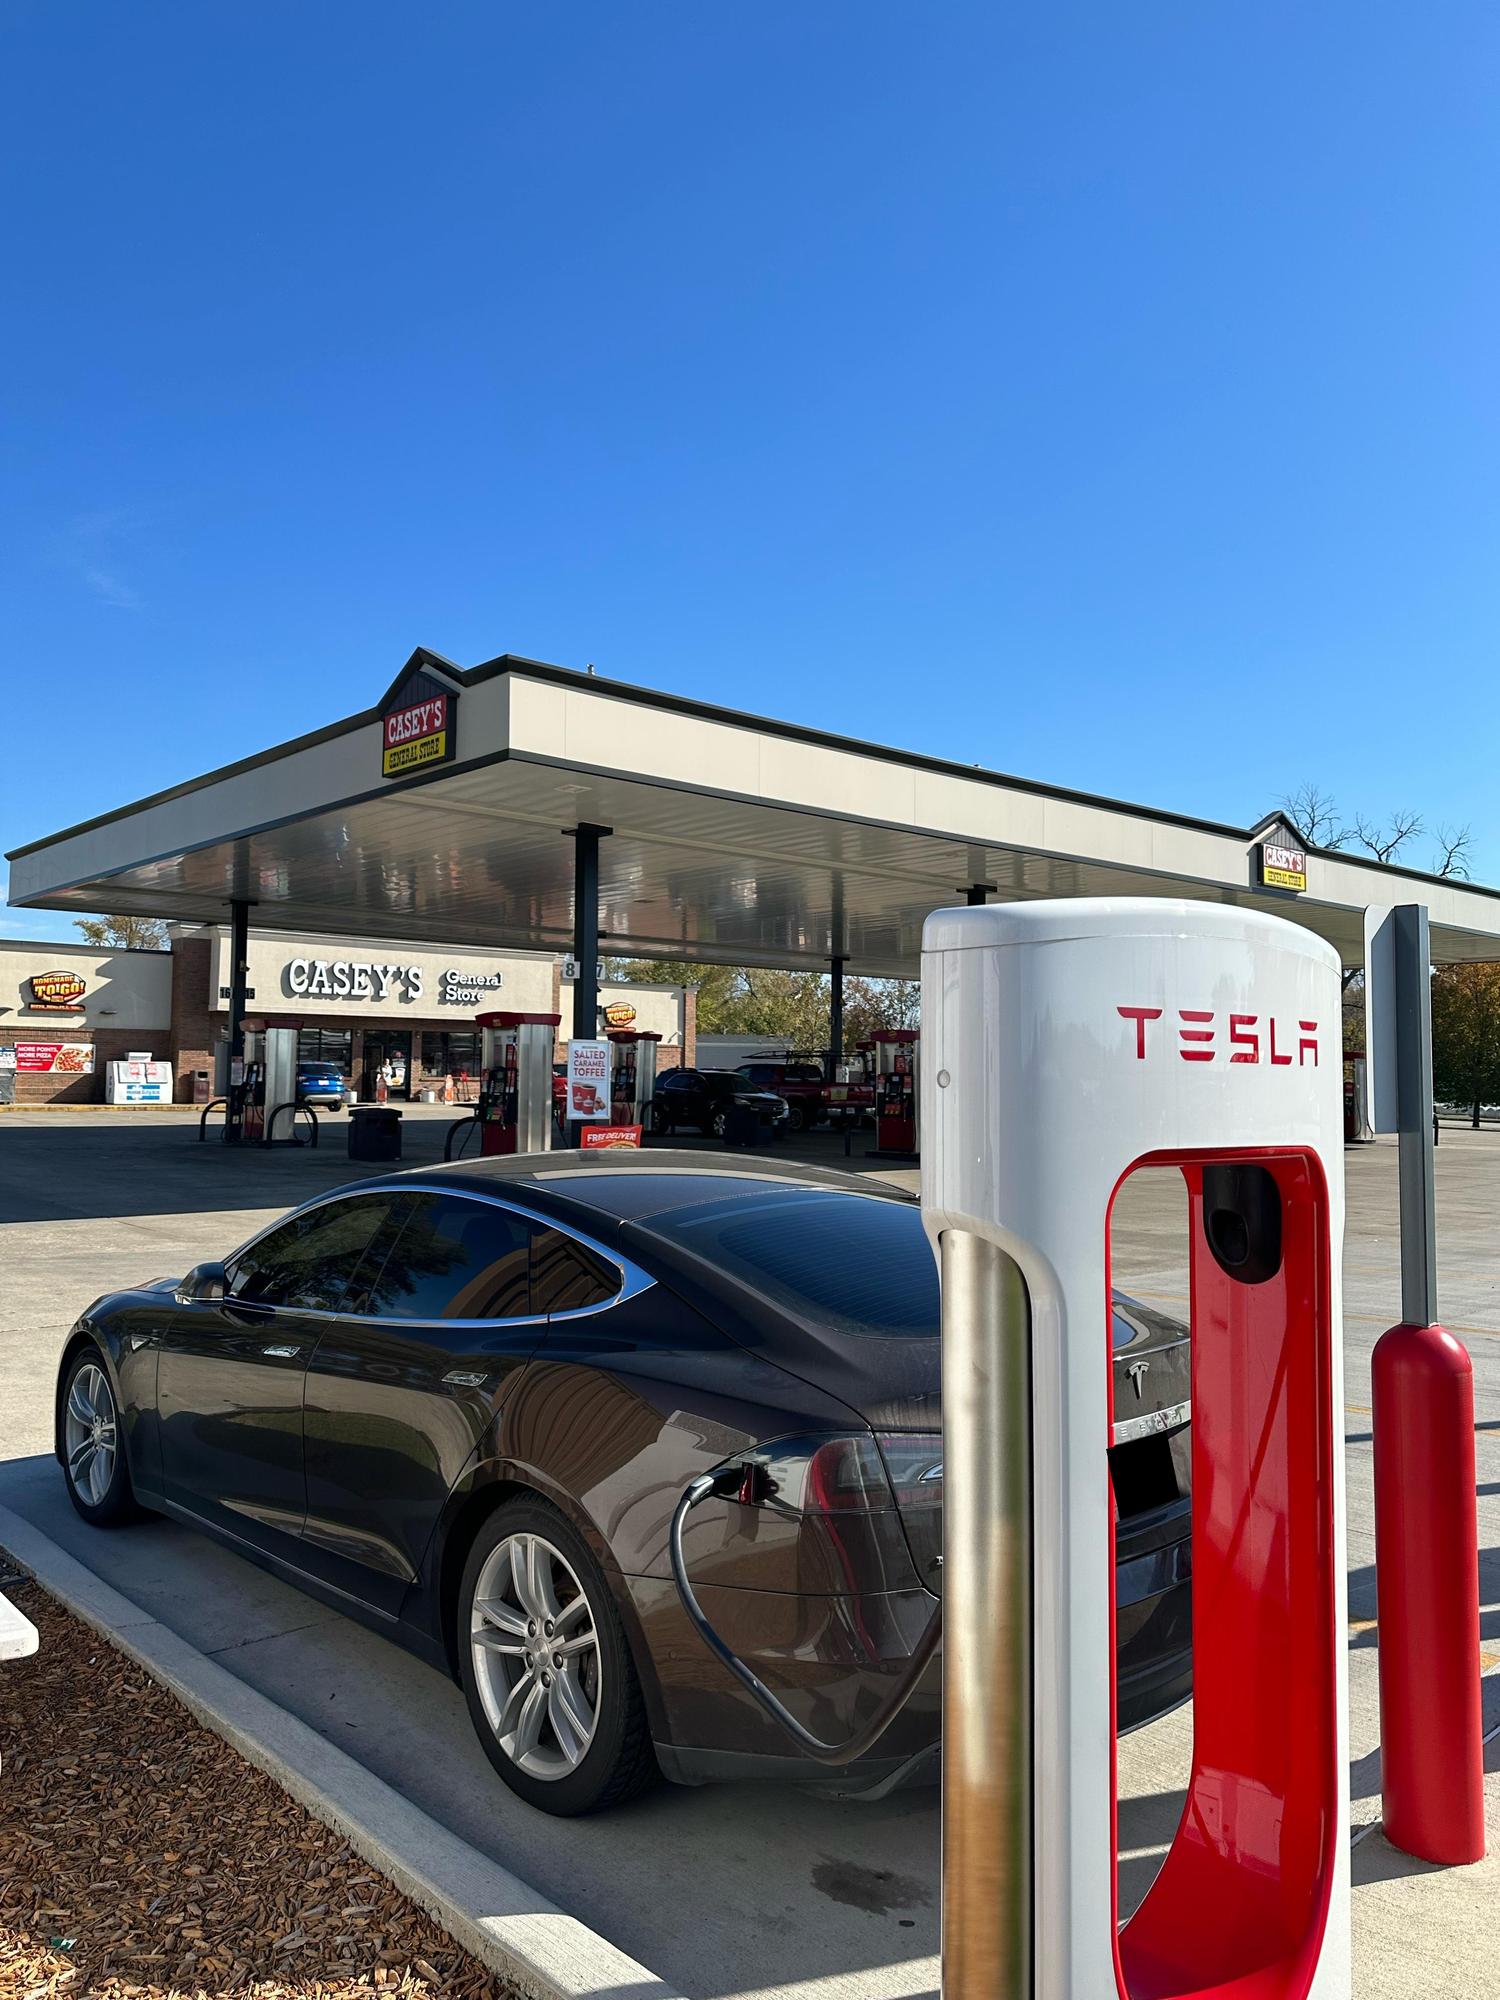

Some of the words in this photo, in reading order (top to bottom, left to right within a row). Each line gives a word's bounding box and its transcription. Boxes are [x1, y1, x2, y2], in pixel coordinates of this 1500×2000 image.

[388, 699, 443, 743] CASEY'S
[1266, 847, 1303, 871] CASEY'S
[445, 968, 504, 988] General
[565, 962, 575, 977] 8
[288, 957, 424, 1000] CASEY'S
[220, 987, 231, 998] 16
[445, 985, 486, 1002] Store
[1116, 1006, 1319, 1067] TESLA
[574, 1050, 606, 1059] SALTED
[573, 1060, 606, 1068] CARAMEL
[573, 1068, 606, 1077] TOFFEE
